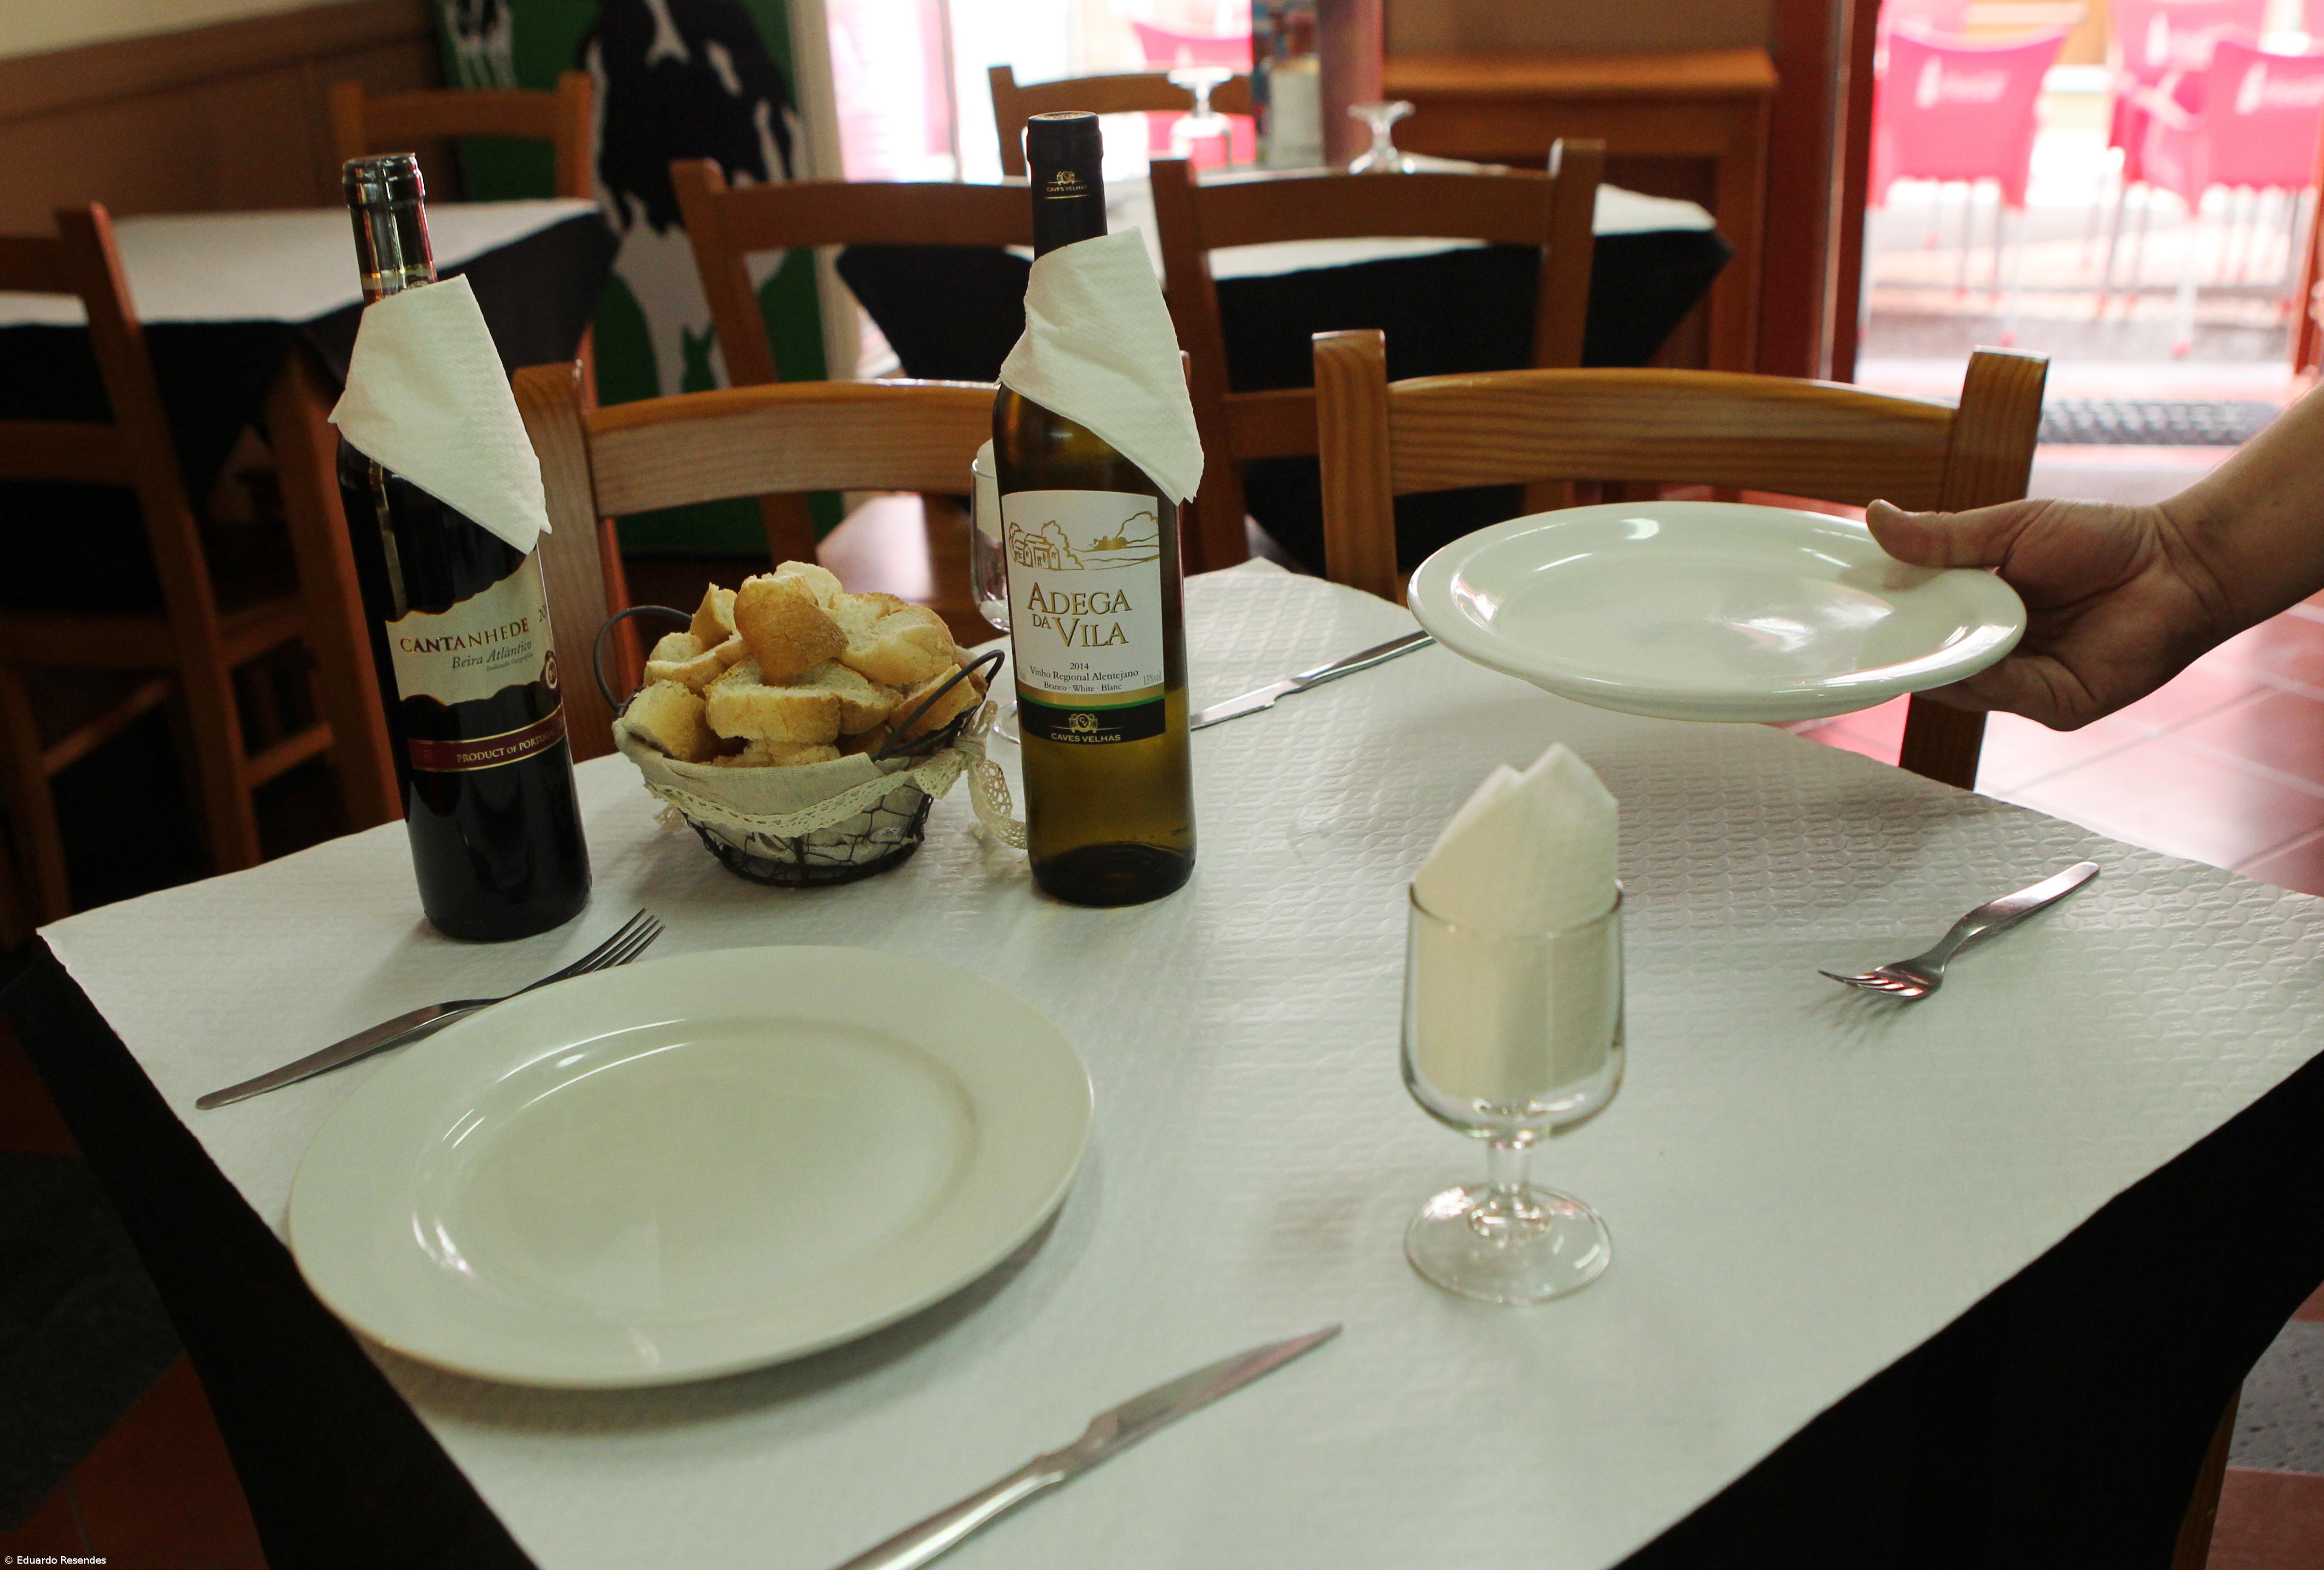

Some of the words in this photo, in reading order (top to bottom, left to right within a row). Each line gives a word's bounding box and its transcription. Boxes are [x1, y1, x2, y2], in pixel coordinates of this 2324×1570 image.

[1027, 582, 1132, 616] ADEGA
[400, 617, 529, 653] CANTANHEDE
[1032, 614, 1052, 629] DA
[1052, 617, 1129, 647] VILA
[452, 656, 483, 669] Beira
[485, 641, 532, 663] Atlântico
[1030, 665, 1051, 679] Vinho
[1053, 671, 1089, 682] Regional
[1091, 670, 1139, 681] Alentejano
[1044, 681, 1067, 691] Branco
[1051, 733, 1080, 743] CAVES
[456, 747, 505, 763] PRODUCT
